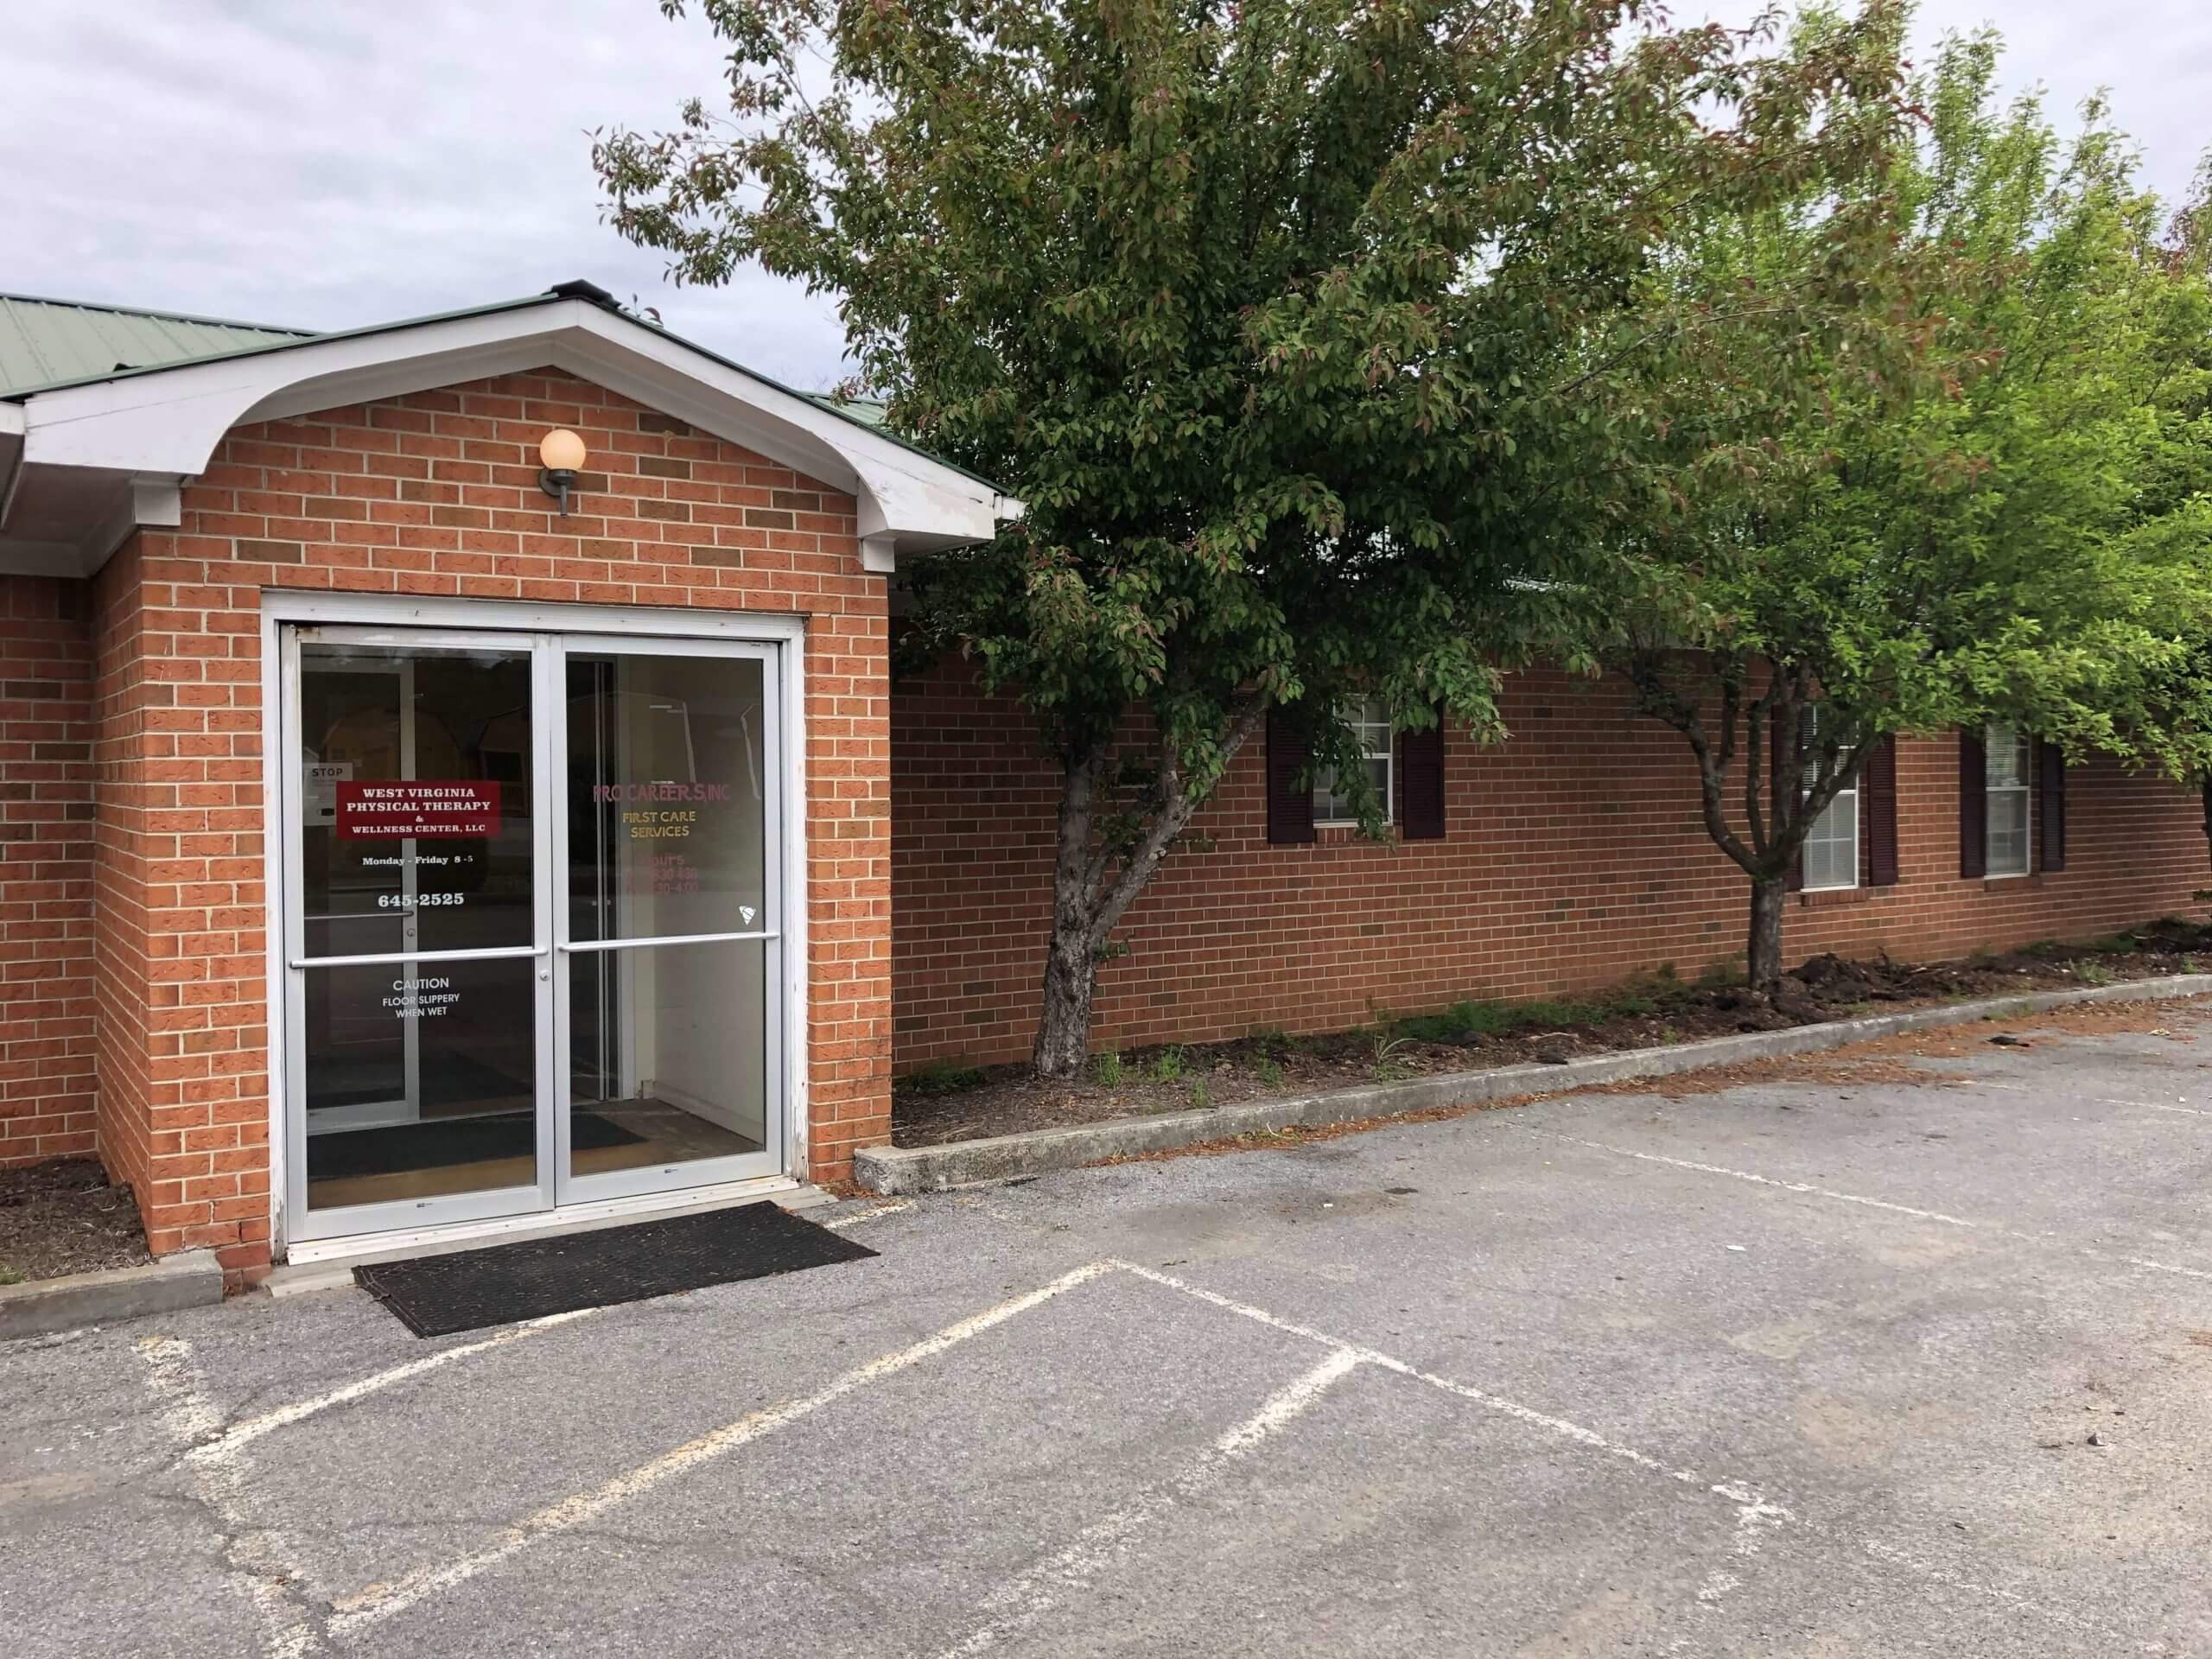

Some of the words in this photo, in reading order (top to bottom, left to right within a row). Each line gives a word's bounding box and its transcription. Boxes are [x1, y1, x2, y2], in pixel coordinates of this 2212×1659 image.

[312, 768, 343, 778] STOP
[363, 788, 404, 798] WEST
[409, 788, 475, 798] VIRGINIA
[593, 785, 622, 803] PRO
[346, 802, 419, 812] PHYSICAL
[423, 801, 492, 810] THERAPY
[622, 812, 658, 823] FIRST
[660, 810, 696, 822] CARE
[415, 824, 463, 833] CENTER,
[631, 826, 690, 838] SERVICES
[362, 857, 405, 866] Monday
[415, 856, 448, 865] Friday
[378, 893, 464, 907] 645-2525
[392, 978, 449, 991] CAUTION
[383, 996, 416, 1007] FLOOR
[418, 994, 460, 1004] SLIPPERY
[395, 1008, 425, 1019] WHEN
[428, 1007, 447, 1016] WET
